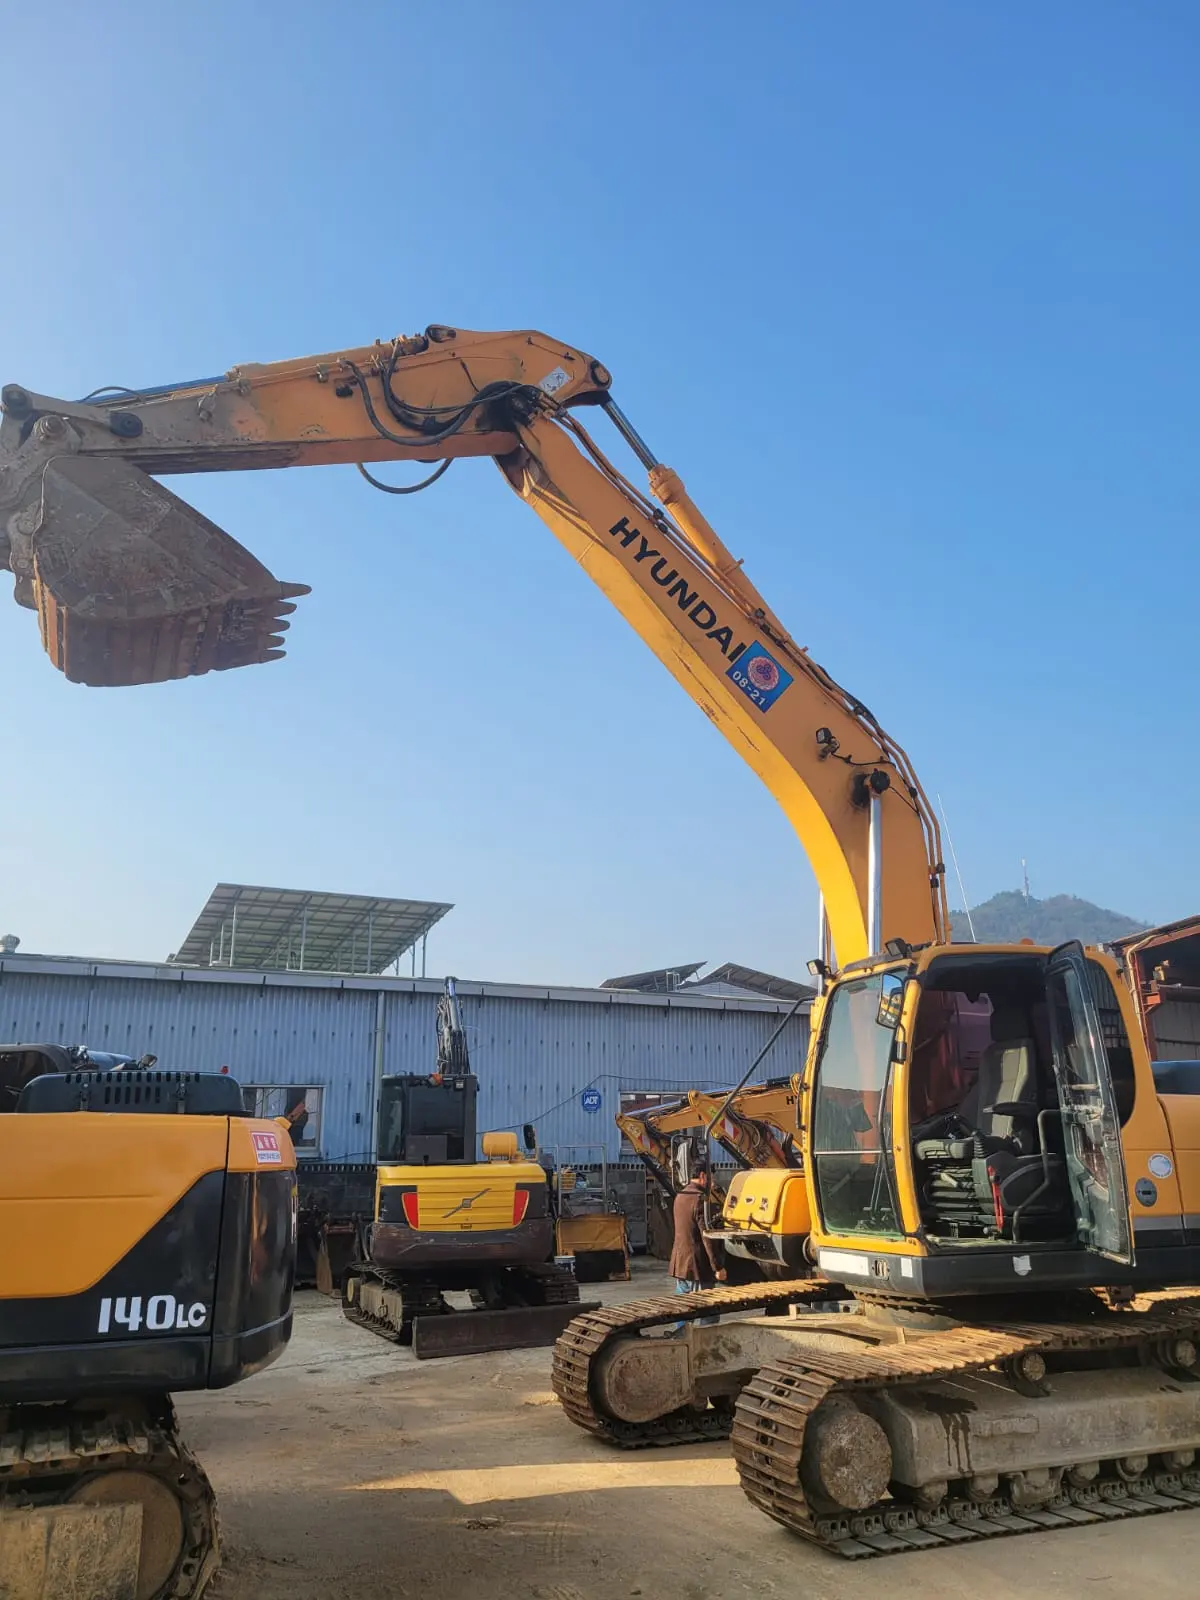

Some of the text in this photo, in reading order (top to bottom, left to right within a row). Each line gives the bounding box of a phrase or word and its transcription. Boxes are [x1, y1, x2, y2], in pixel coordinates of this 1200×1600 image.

[608, 516, 748, 663] HYUNDAI
[732, 671, 766, 706] 08-21
[584, 1095, 599, 1105] ADT
[98, 1294, 207, 1333] 140LC
